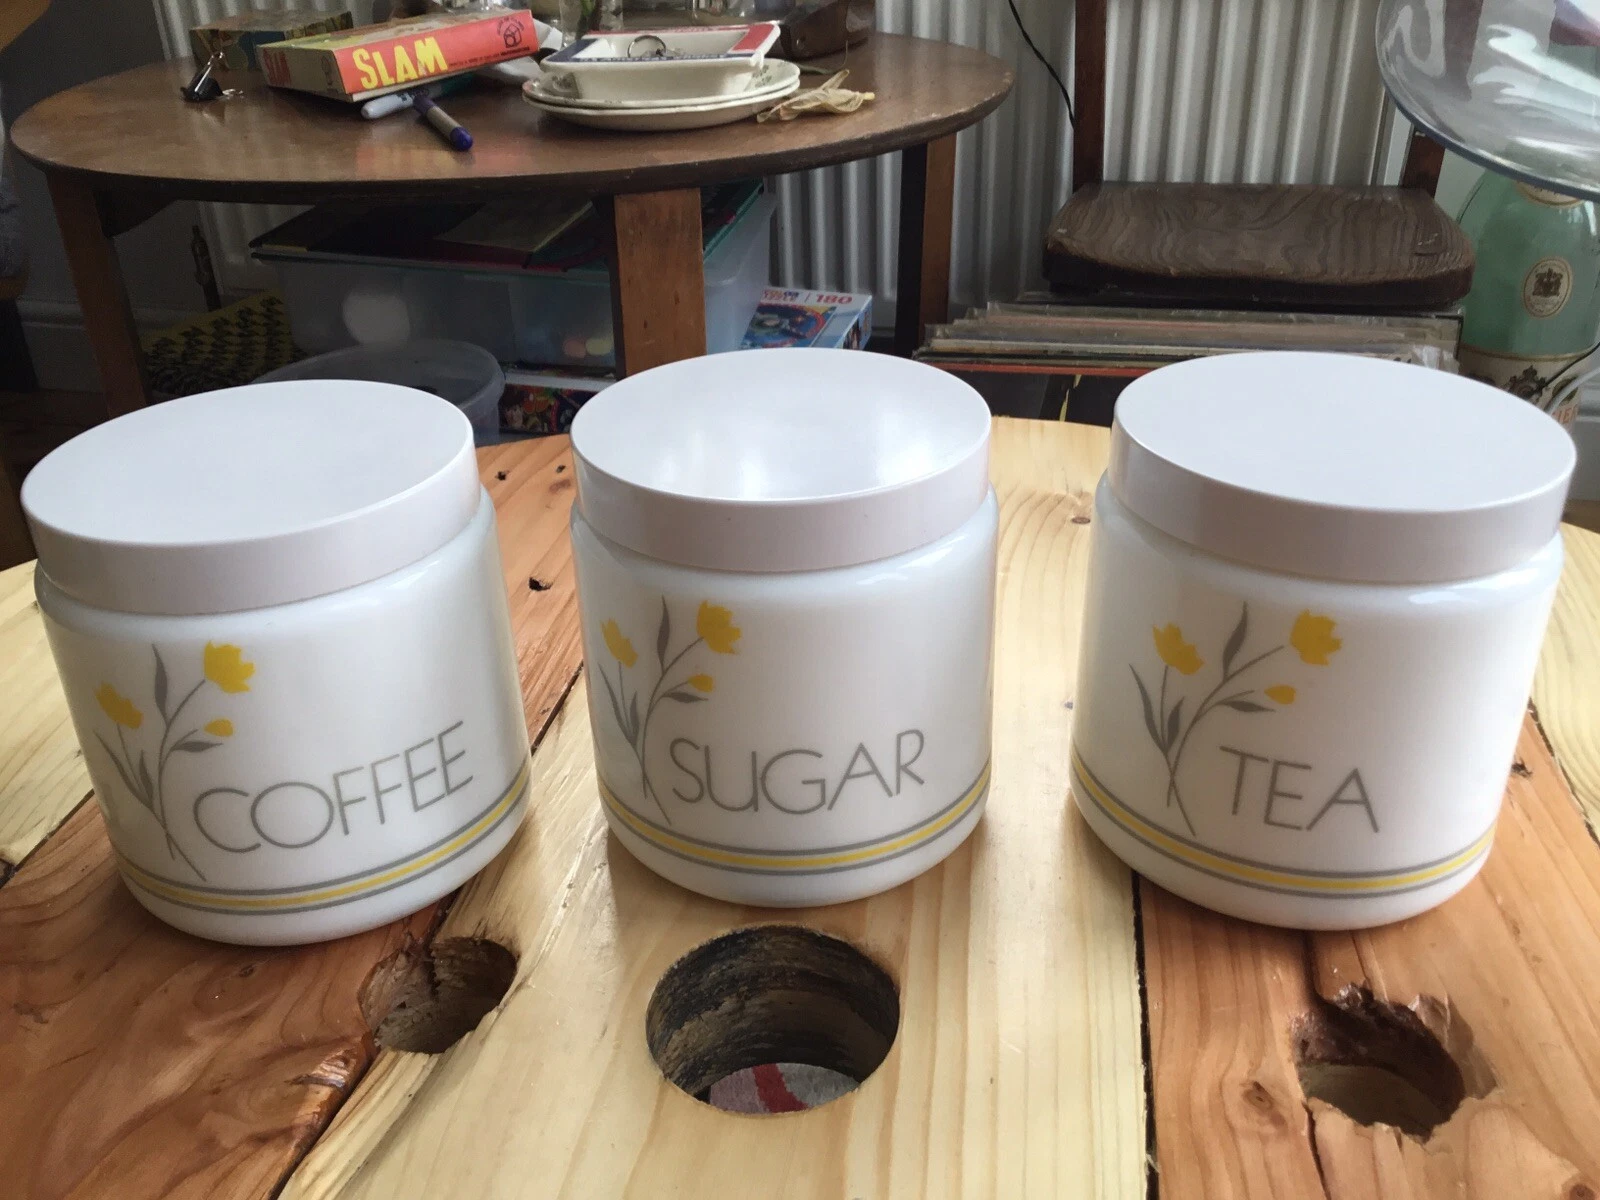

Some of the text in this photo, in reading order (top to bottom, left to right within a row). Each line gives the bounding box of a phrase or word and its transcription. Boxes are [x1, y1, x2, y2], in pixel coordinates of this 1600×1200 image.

[353, 36, 448, 89] SLAM
[816, 294, 853, 305] 180
[193, 720, 474, 853] COFFEE
[669, 729, 925, 815] SUGAR
[1218, 745, 1380, 833] TEA
